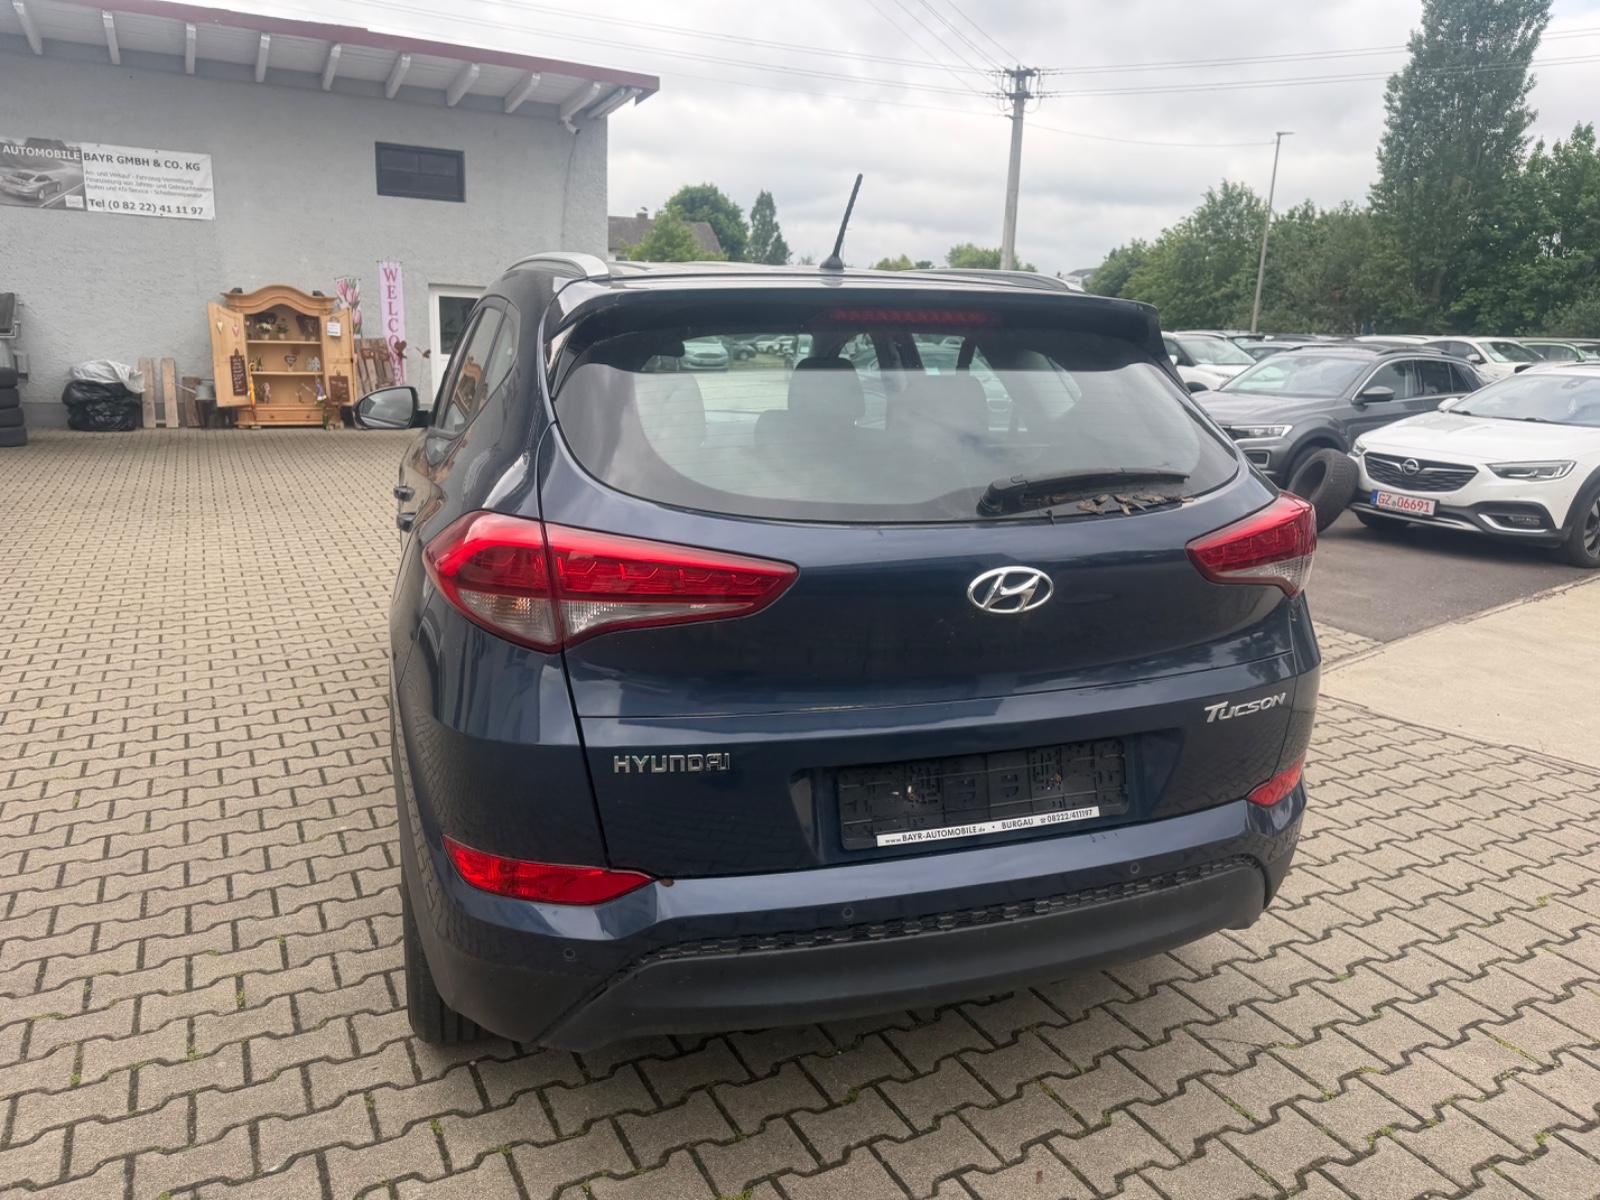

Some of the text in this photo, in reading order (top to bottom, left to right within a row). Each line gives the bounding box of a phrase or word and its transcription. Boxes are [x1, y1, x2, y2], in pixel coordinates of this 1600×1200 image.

[3, 145, 201, 172] AUTOMOBILE BAYR GMBH & CO. KG
[88, 198, 105, 208] Tel
[108, 199, 120, 210] (0
[122, 200, 136, 210] 82
[139, 202, 157, 214] 22)
[160, 204, 172, 213] 41
[175, 206, 188, 214] 11
[191, 206, 204, 215] 97
[1378, 493, 1431, 513] GZ 06691
[1204, 692, 1287, 724] TUCSON
[613, 752, 731, 774] HYUNDAI
[1001, 818, 1034, 830] BURGAU
